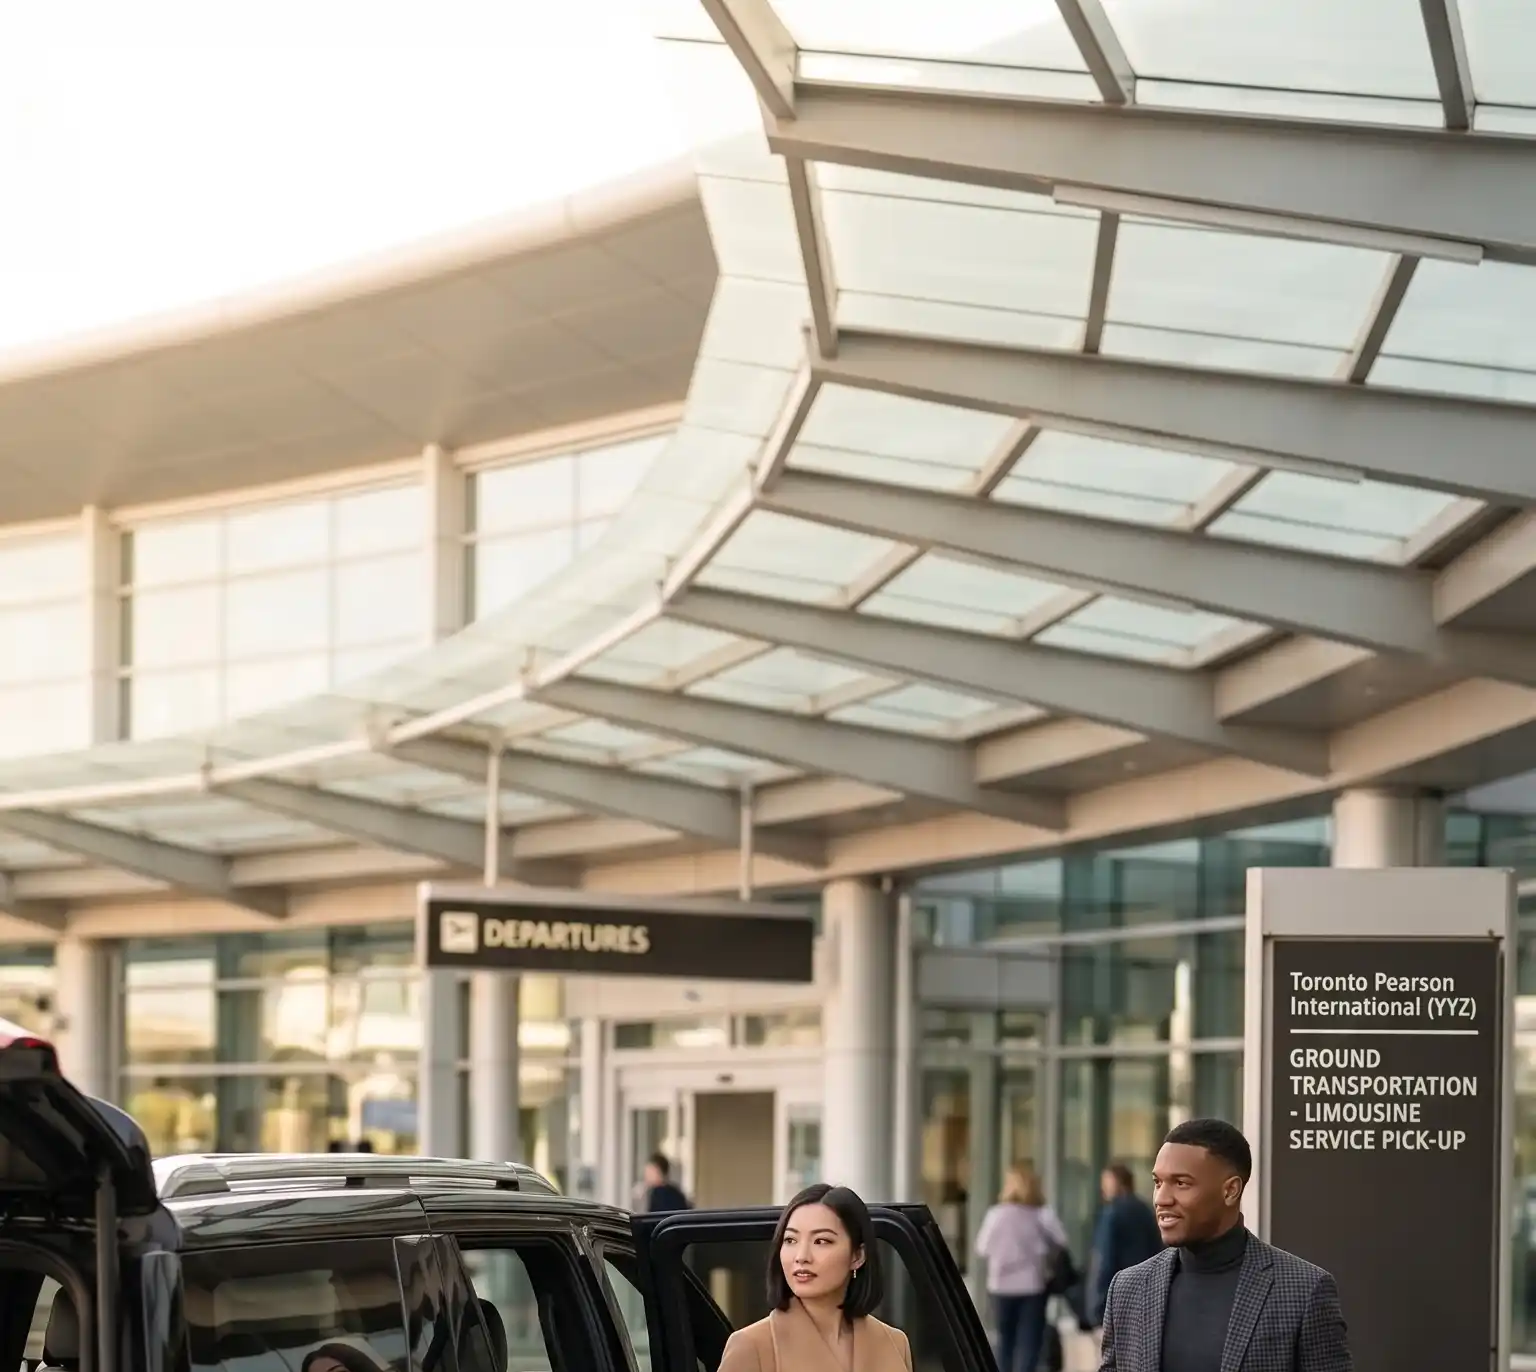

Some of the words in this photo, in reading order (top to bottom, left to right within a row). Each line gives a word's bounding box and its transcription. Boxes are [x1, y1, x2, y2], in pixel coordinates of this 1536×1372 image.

[484, 918, 650, 953] DEPARTURES
[1290, 972, 1368, 992] Toronto
[1374, 972, 1454, 992] Pearson
[1290, 996, 1421, 1017] International
[1427, 997, 1477, 1020] (YYZ)
[1289, 1049, 1381, 1068] GROUND
[1289, 1076, 1477, 1096] TRANSPORTATION
[1305, 1103, 1421, 1122] LIMOUSINE
[1289, 1130, 1376, 1149] SERVICE
[1382, 1130, 1466, 1150] PICK-UP
